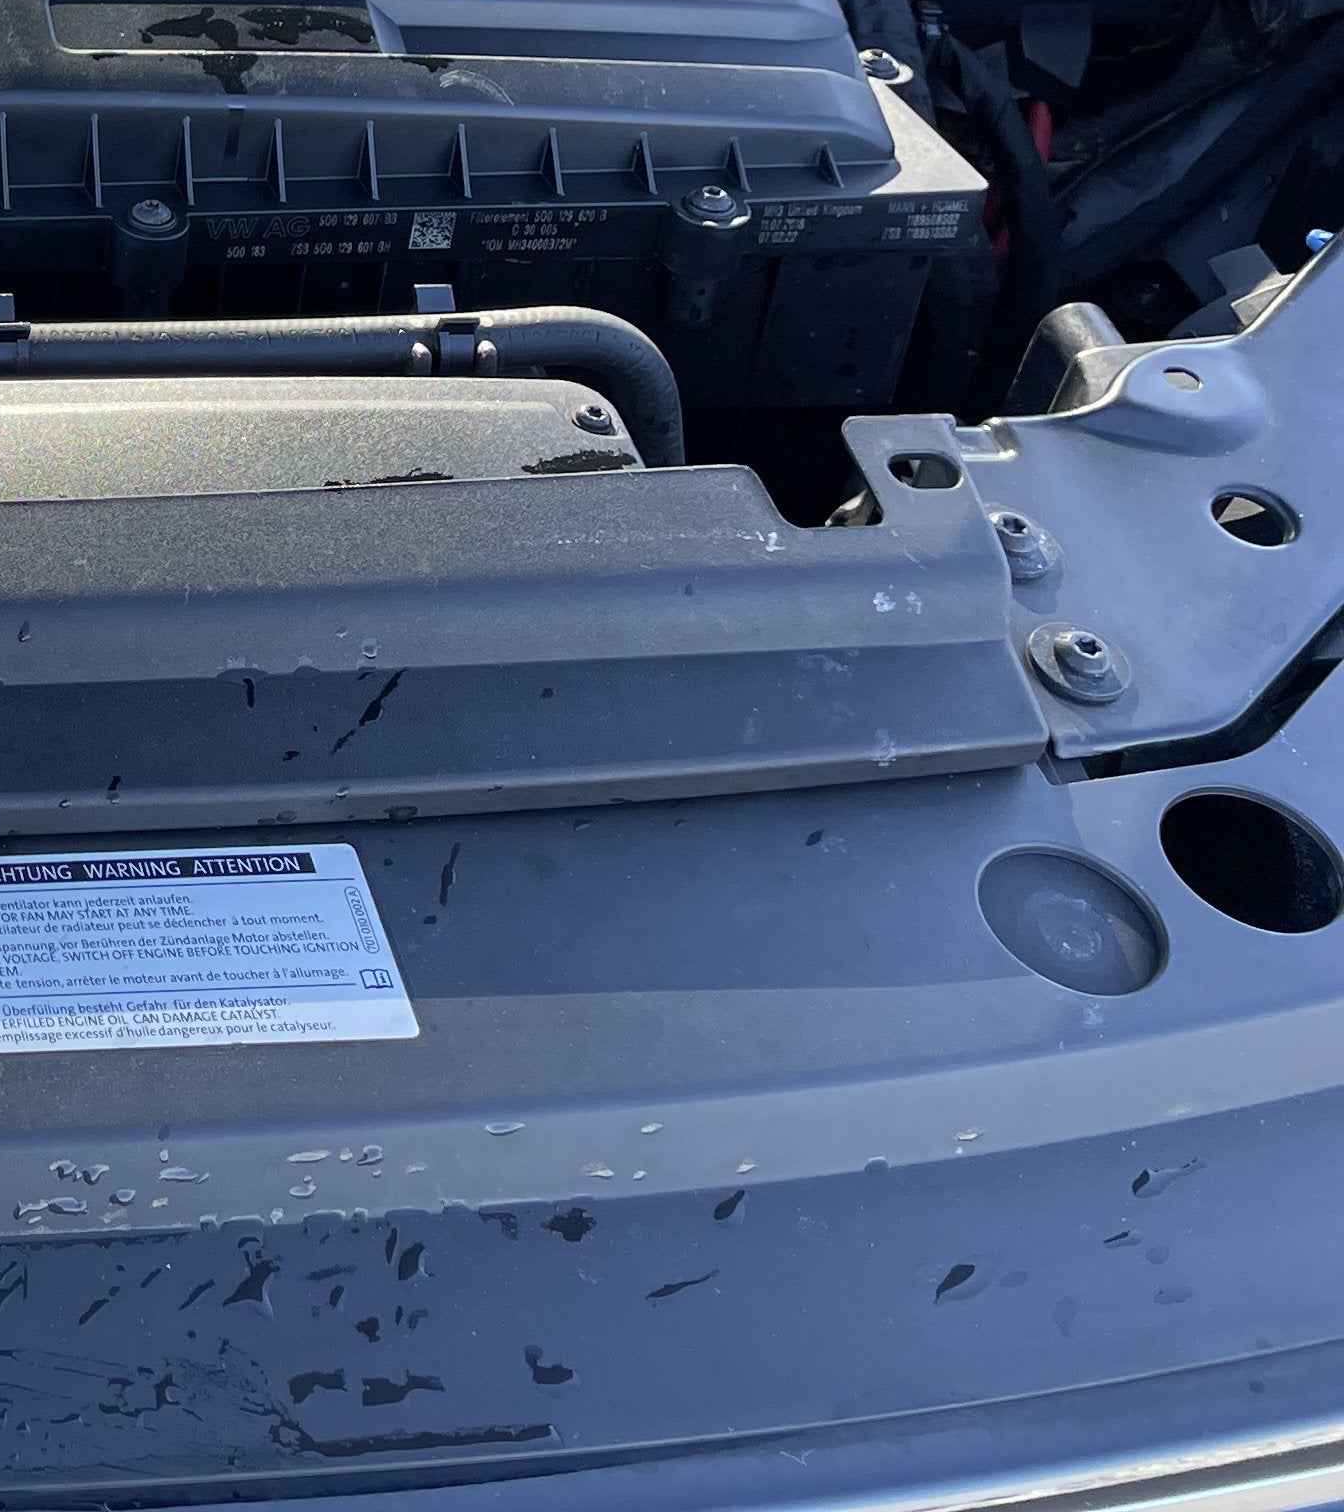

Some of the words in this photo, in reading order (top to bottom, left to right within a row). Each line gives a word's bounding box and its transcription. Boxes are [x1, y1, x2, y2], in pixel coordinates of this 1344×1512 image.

[206, 218, 258, 240] VW
[263, 216, 312, 237] AG
[83, 861, 180, 880] WARNING
[193, 856, 301, 874] ATTENTION
[21, 912, 44, 921] FAN
[47, 910, 74, 921] MAY
[78, 908, 111, 919] START
[116, 908, 129, 918] AT
[133, 907, 157, 917] ANY
[160, 906, 194, 916] TIME.
[63, 951, 110, 962] SWITCH
[113, 950, 134, 961] OFF
[139, 947, 184, 959] ENGINE
[187, 945, 231, 958] BEFORE
[236, 943, 301, 956] TOUCHING
[304, 941, 359, 953] IGNITION
[59, 1016, 104, 1027] ENGINE
[107, 1015, 128, 1025] OIL
[133, 1013, 160, 1024] CAN
[163, 1010, 218, 1023] DAMAGE
